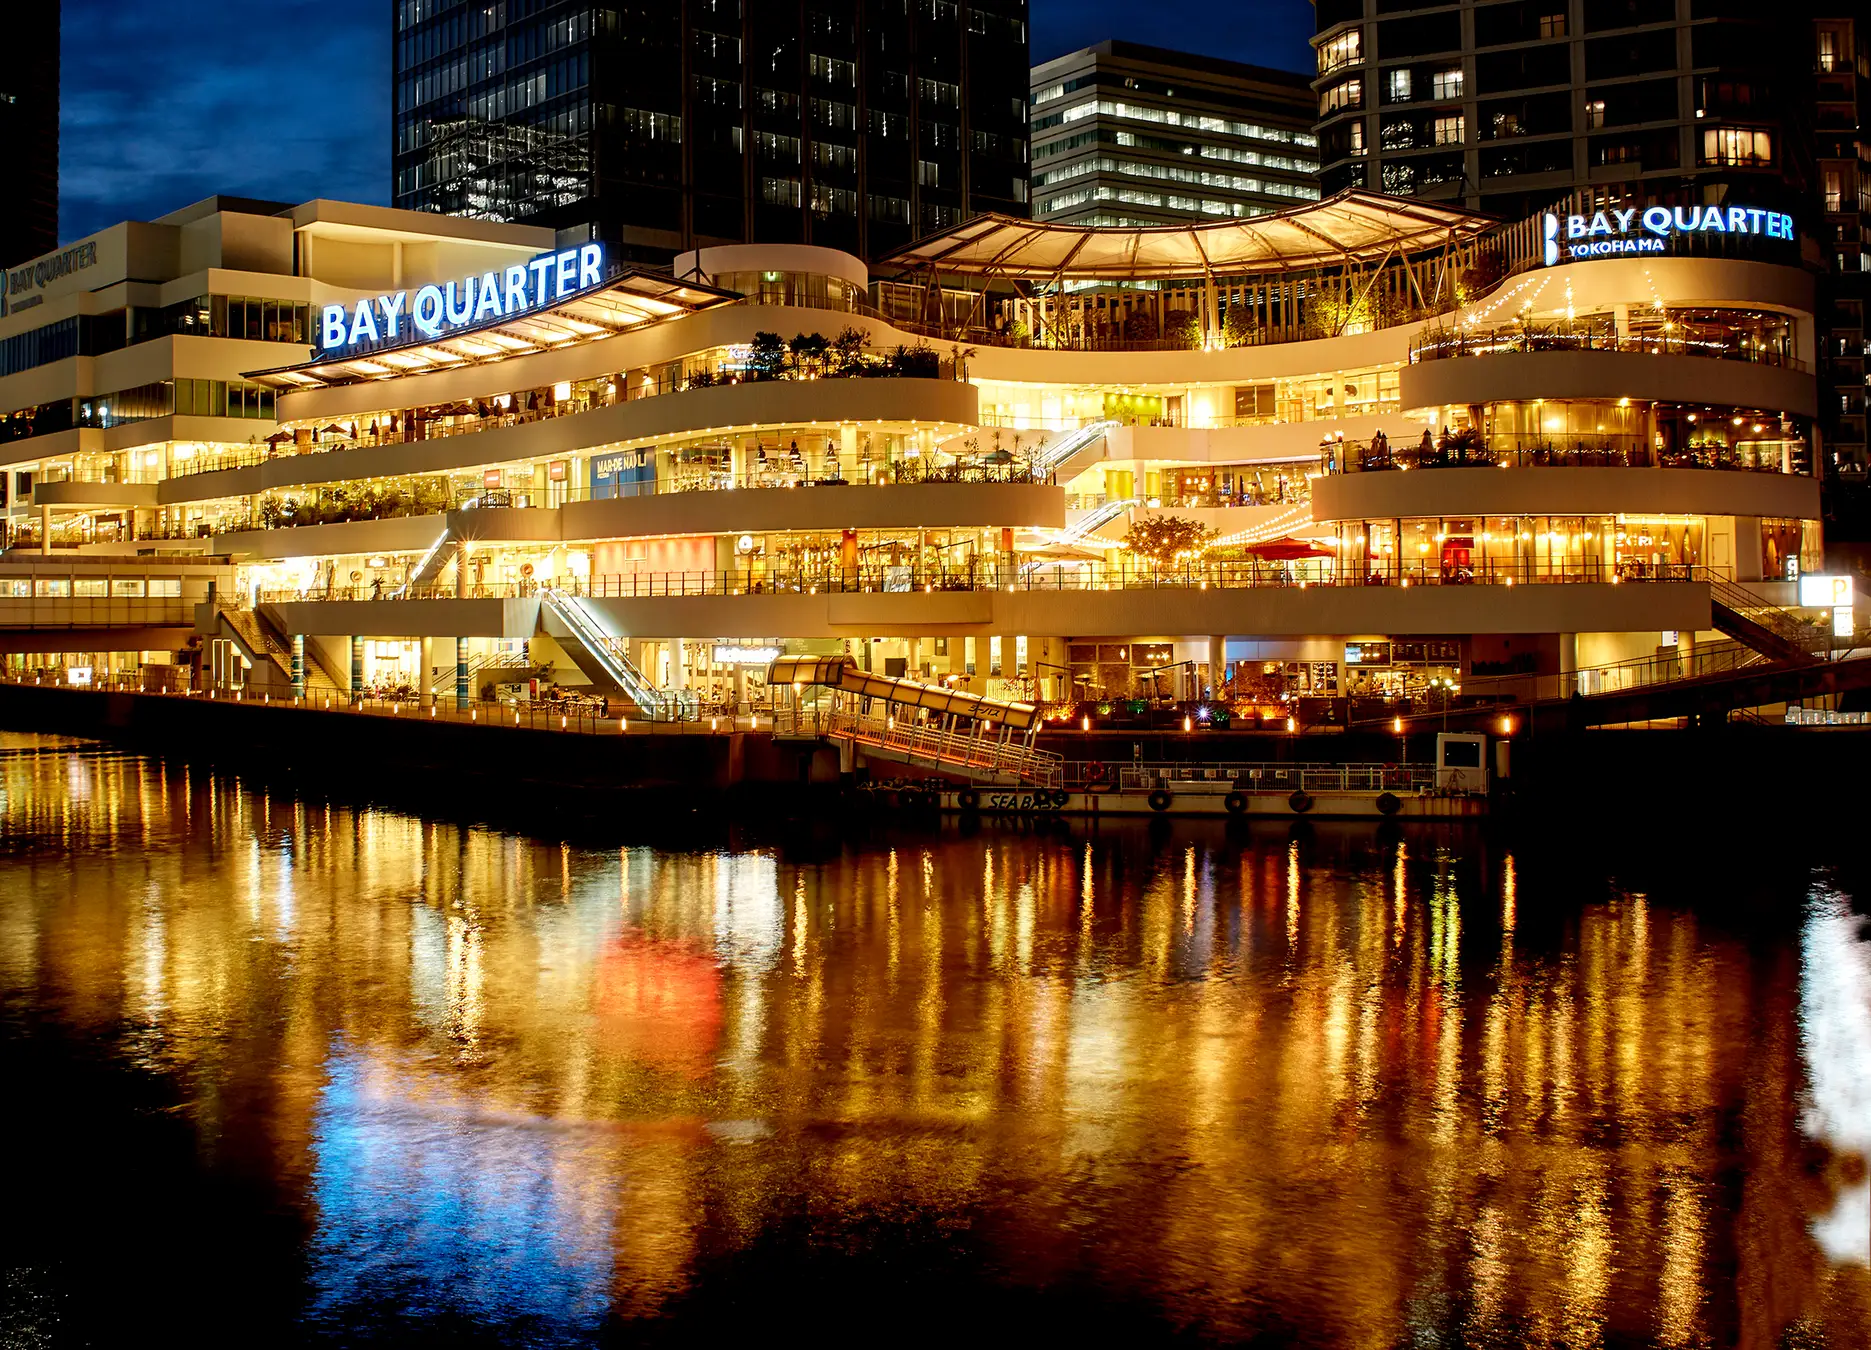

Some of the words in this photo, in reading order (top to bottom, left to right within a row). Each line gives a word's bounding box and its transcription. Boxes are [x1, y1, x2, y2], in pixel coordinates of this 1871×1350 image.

[1568, 208, 1635, 238] BAY
[1643, 205, 1794, 240] QUARTER
[1568, 239, 1665, 257] YOKOHAMA
[10, 265, 34, 295] BAY
[34, 241, 97, 288] QUARTER
[322, 291, 407, 350] BAY
[413, 242, 605, 338] QUARTER
[1832, 578, 1848, 604] P
[987, 795, 1018, 809] SEA
